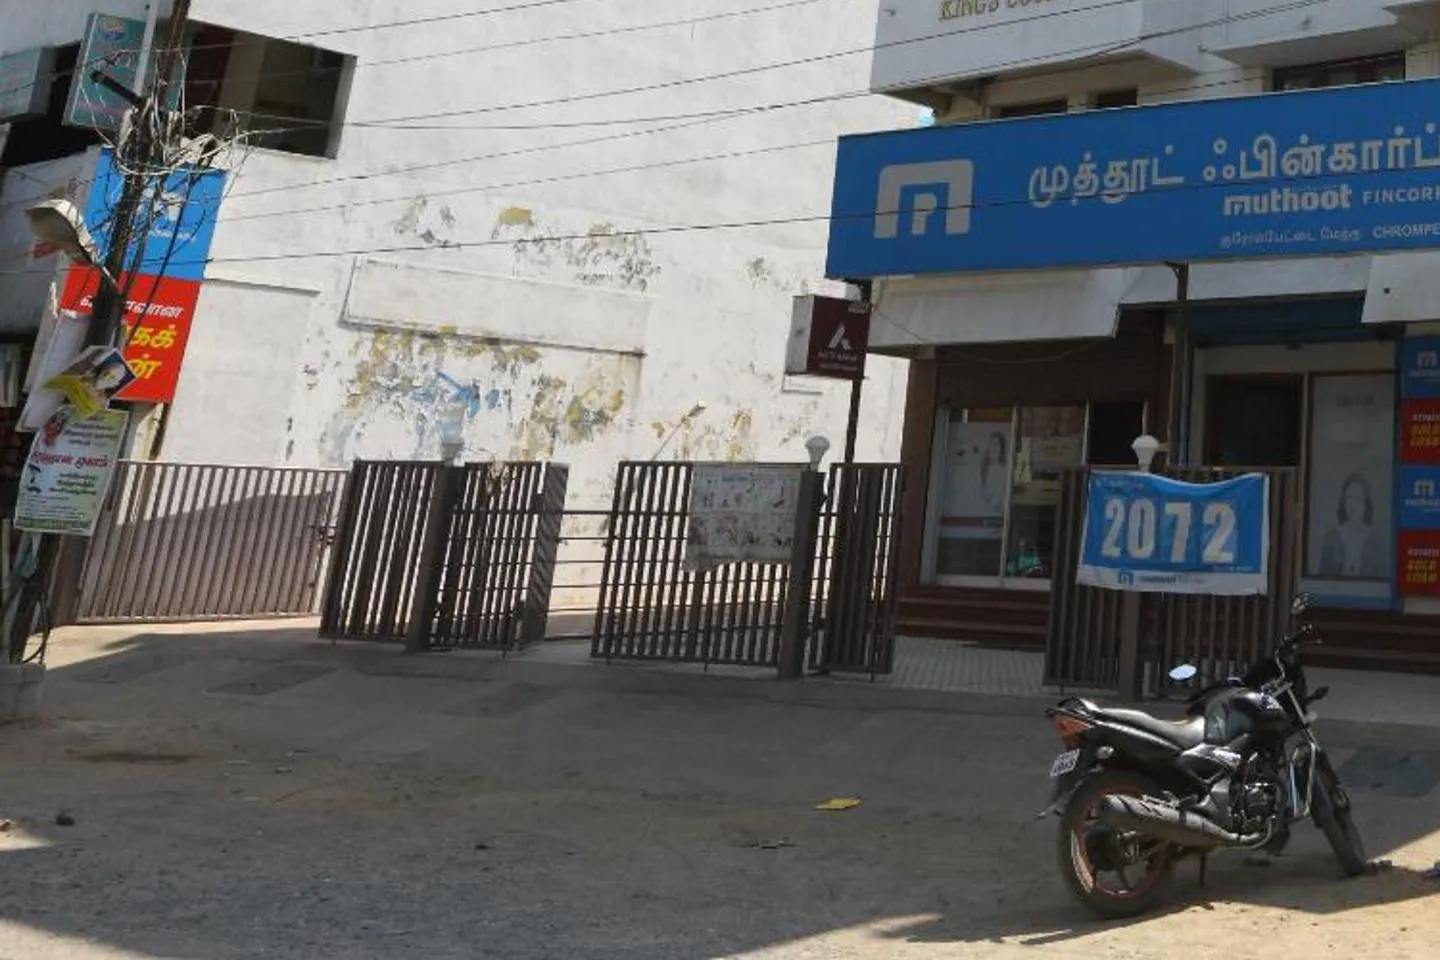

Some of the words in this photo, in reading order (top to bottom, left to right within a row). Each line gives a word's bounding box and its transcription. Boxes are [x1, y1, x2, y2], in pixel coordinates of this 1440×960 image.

[1028, 144, 1185, 209] முத்தூட்
[1222, 182, 1353, 216] muthoot
[1101, 498, 1236, 564] 2072
